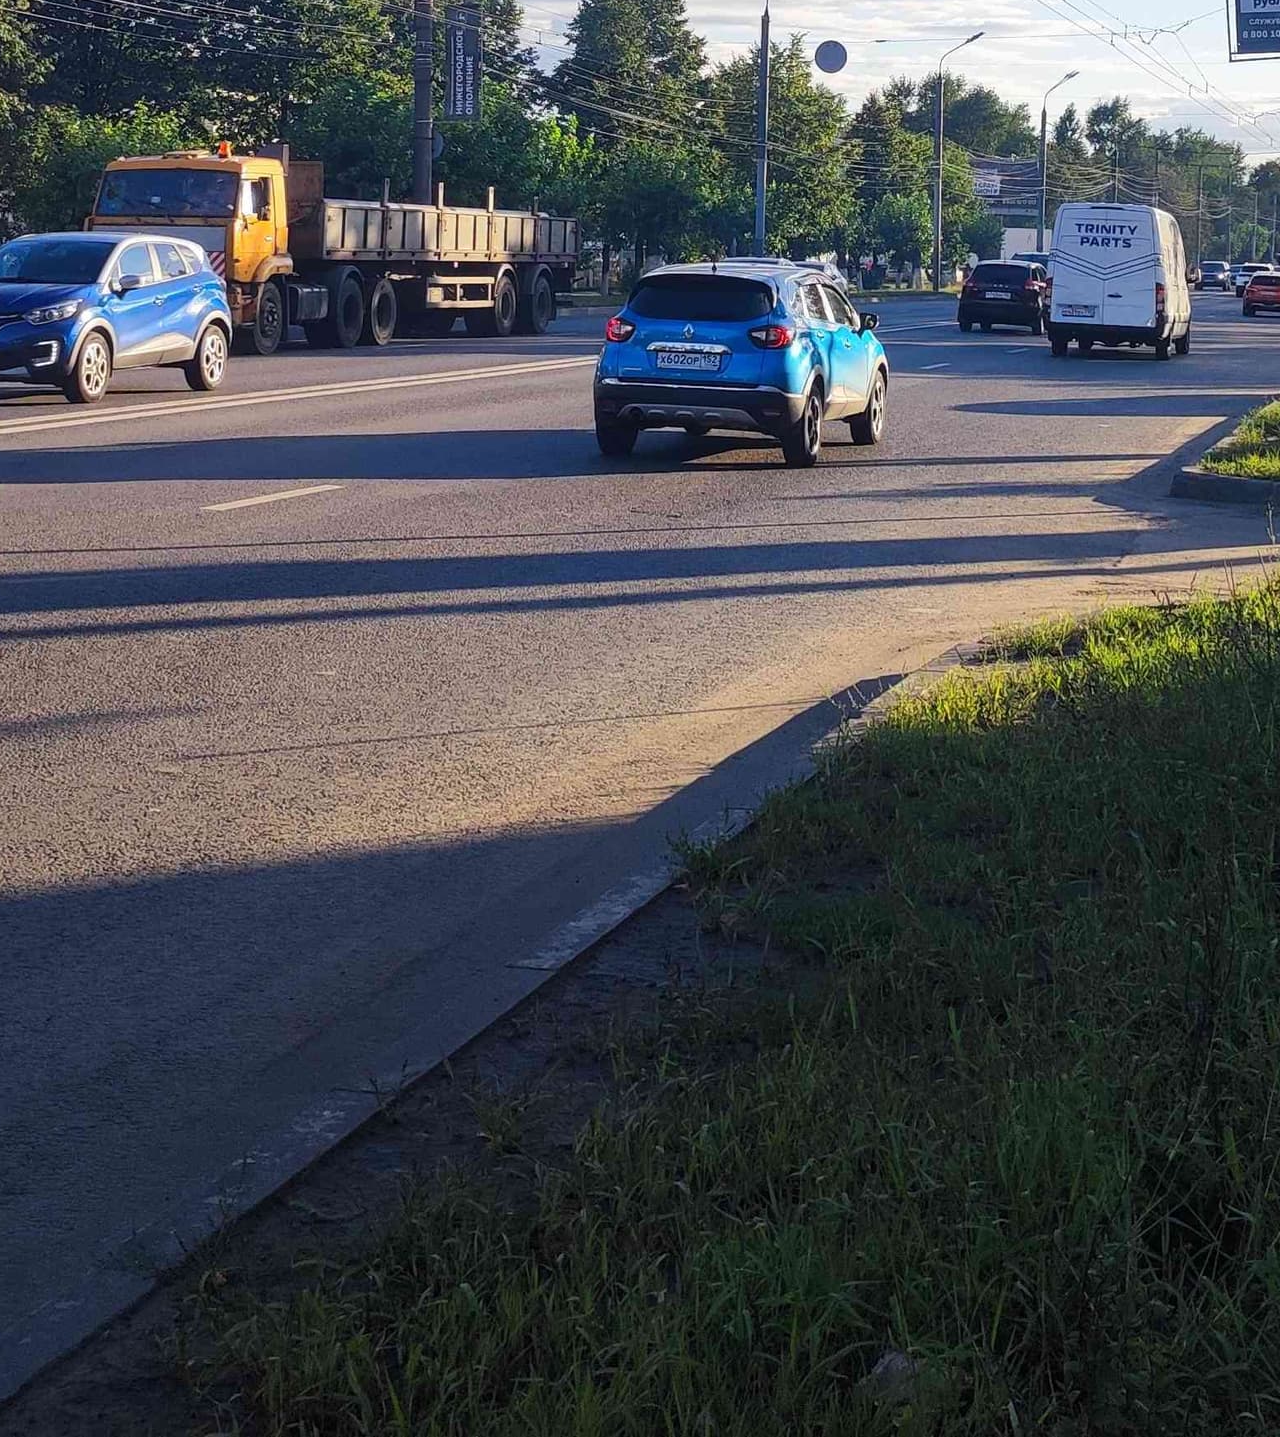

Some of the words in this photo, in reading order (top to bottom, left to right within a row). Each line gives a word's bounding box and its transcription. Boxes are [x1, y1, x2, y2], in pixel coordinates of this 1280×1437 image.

[455, 29, 465, 115] НИЖЕГОРОДСКОЕ
[465, 55, 474, 116] ОПОЛЧЕНИЕ
[1074, 223, 1139, 236] TRINITY
[1079, 236, 1132, 249] PARTS
